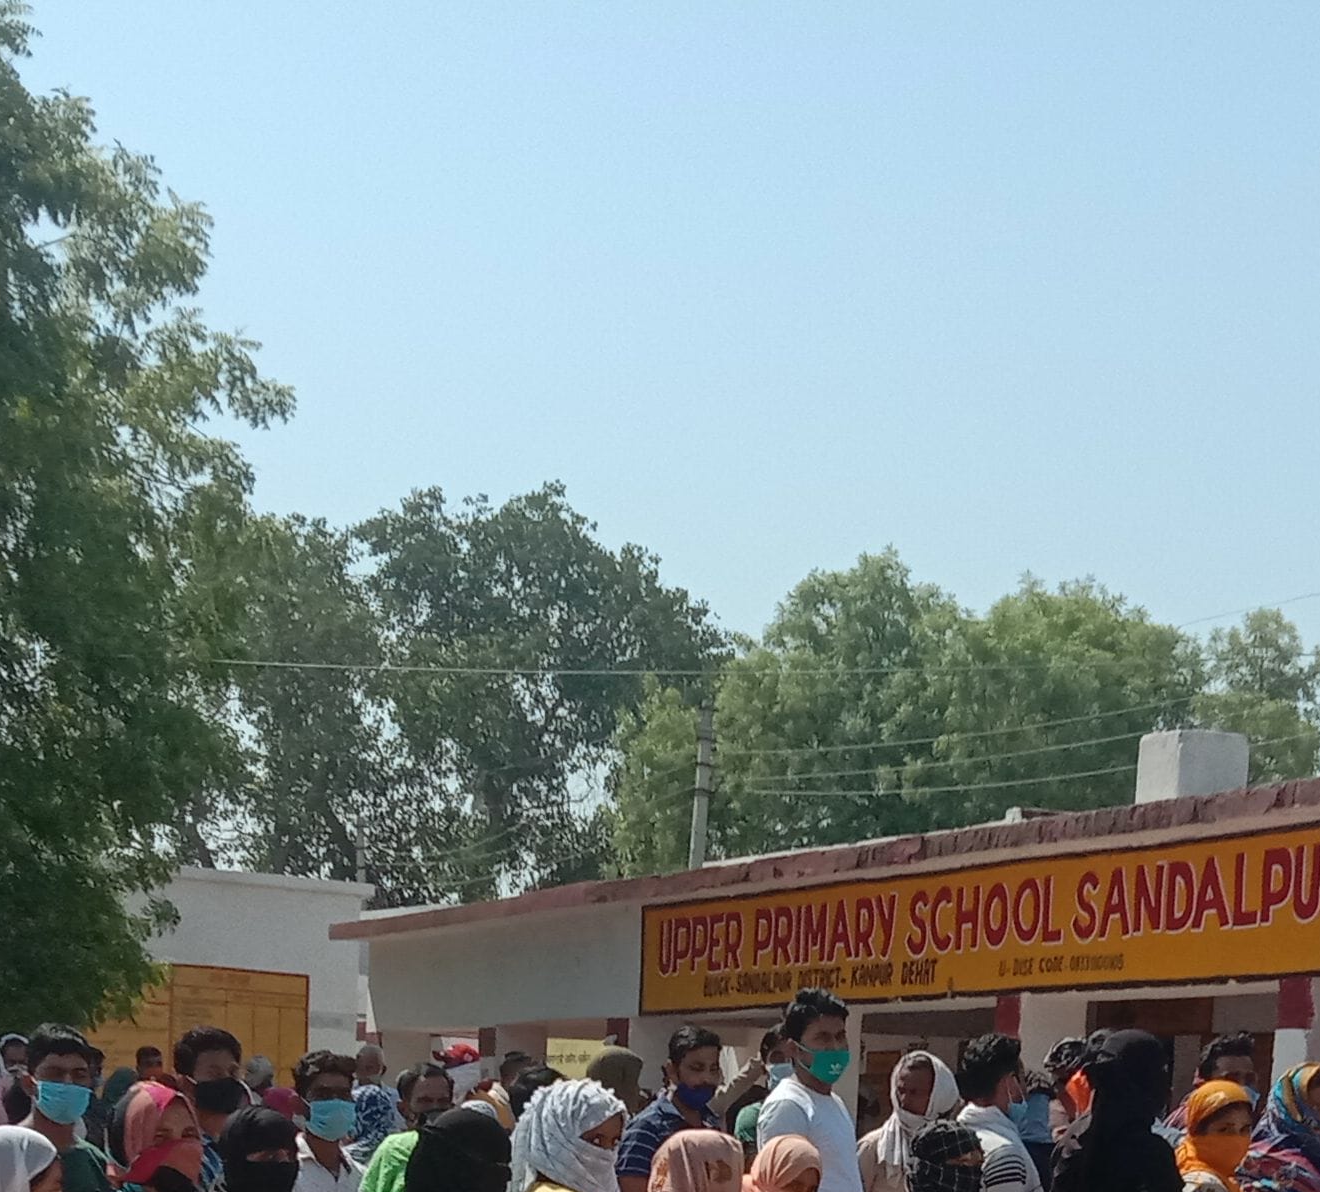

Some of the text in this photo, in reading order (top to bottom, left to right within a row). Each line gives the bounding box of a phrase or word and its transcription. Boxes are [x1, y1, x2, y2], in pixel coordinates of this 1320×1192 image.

[658, 911, 743, 976] UPPER
[752, 892, 898, 968] PRIMARY
[905, 875, 1063, 958] SCHOOL
[850, 962, 895, 988] KANPUR
[901, 958, 939, 985] DEHAT
